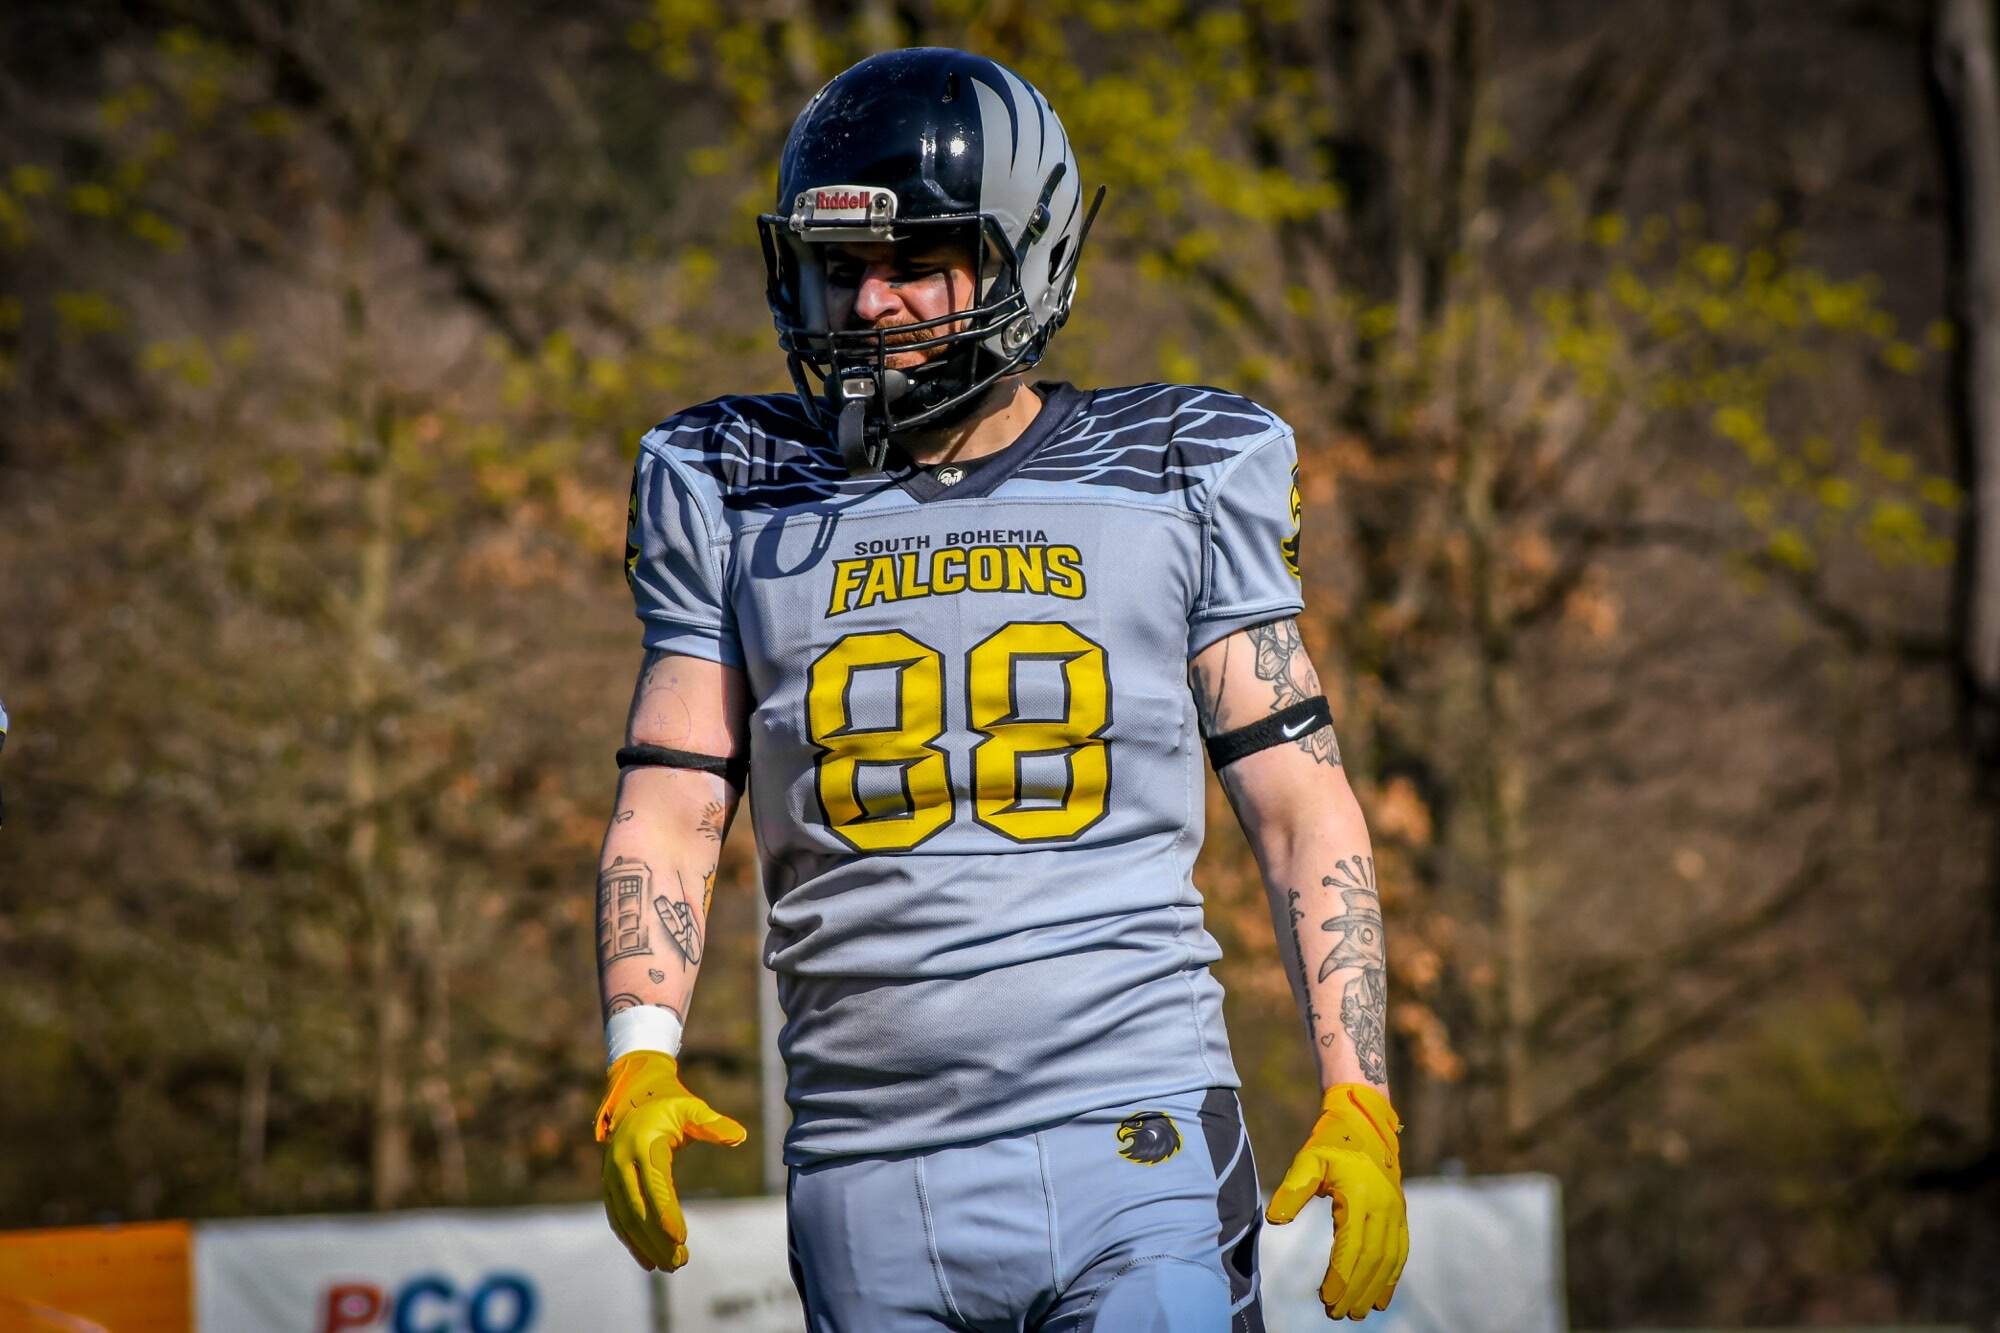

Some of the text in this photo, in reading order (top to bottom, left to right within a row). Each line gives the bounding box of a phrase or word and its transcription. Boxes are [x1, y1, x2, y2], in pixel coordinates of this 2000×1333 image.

[815, 191, 871, 209] Riddell
[854, 529, 1049, 556] SOUTH BOHEMIA
[824, 543, 1087, 619] FALCONS
[806, 620, 1113, 852] 88
